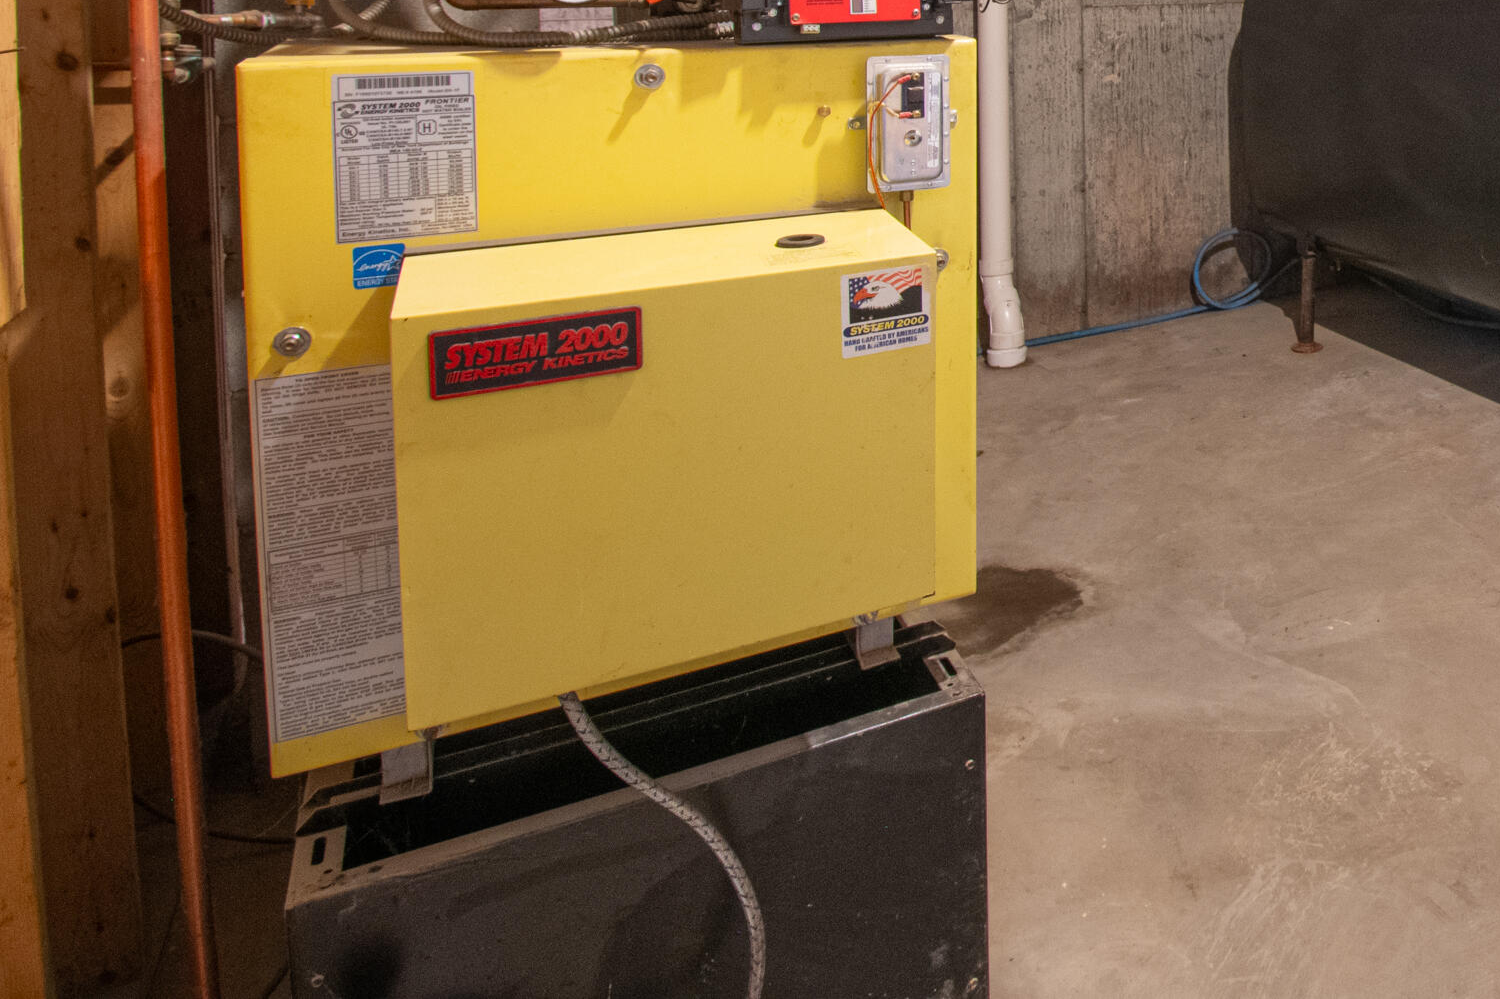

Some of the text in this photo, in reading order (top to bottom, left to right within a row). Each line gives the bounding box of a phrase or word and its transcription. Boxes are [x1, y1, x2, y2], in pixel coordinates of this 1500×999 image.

[425, 97, 470, 105] FRONTIER
[422, 122, 432, 133] H
[850, 316, 925, 336] SYSTEM 2000
[888, 332, 896, 340] BY
[896, 327, 929, 338] AMERICANS
[445, 322, 629, 370] SYSTEM 2000
[855, 344, 866, 352] FOR
[898, 336, 918, 344] HOMES
[459, 347, 629, 382] ENERGY KINETICS
